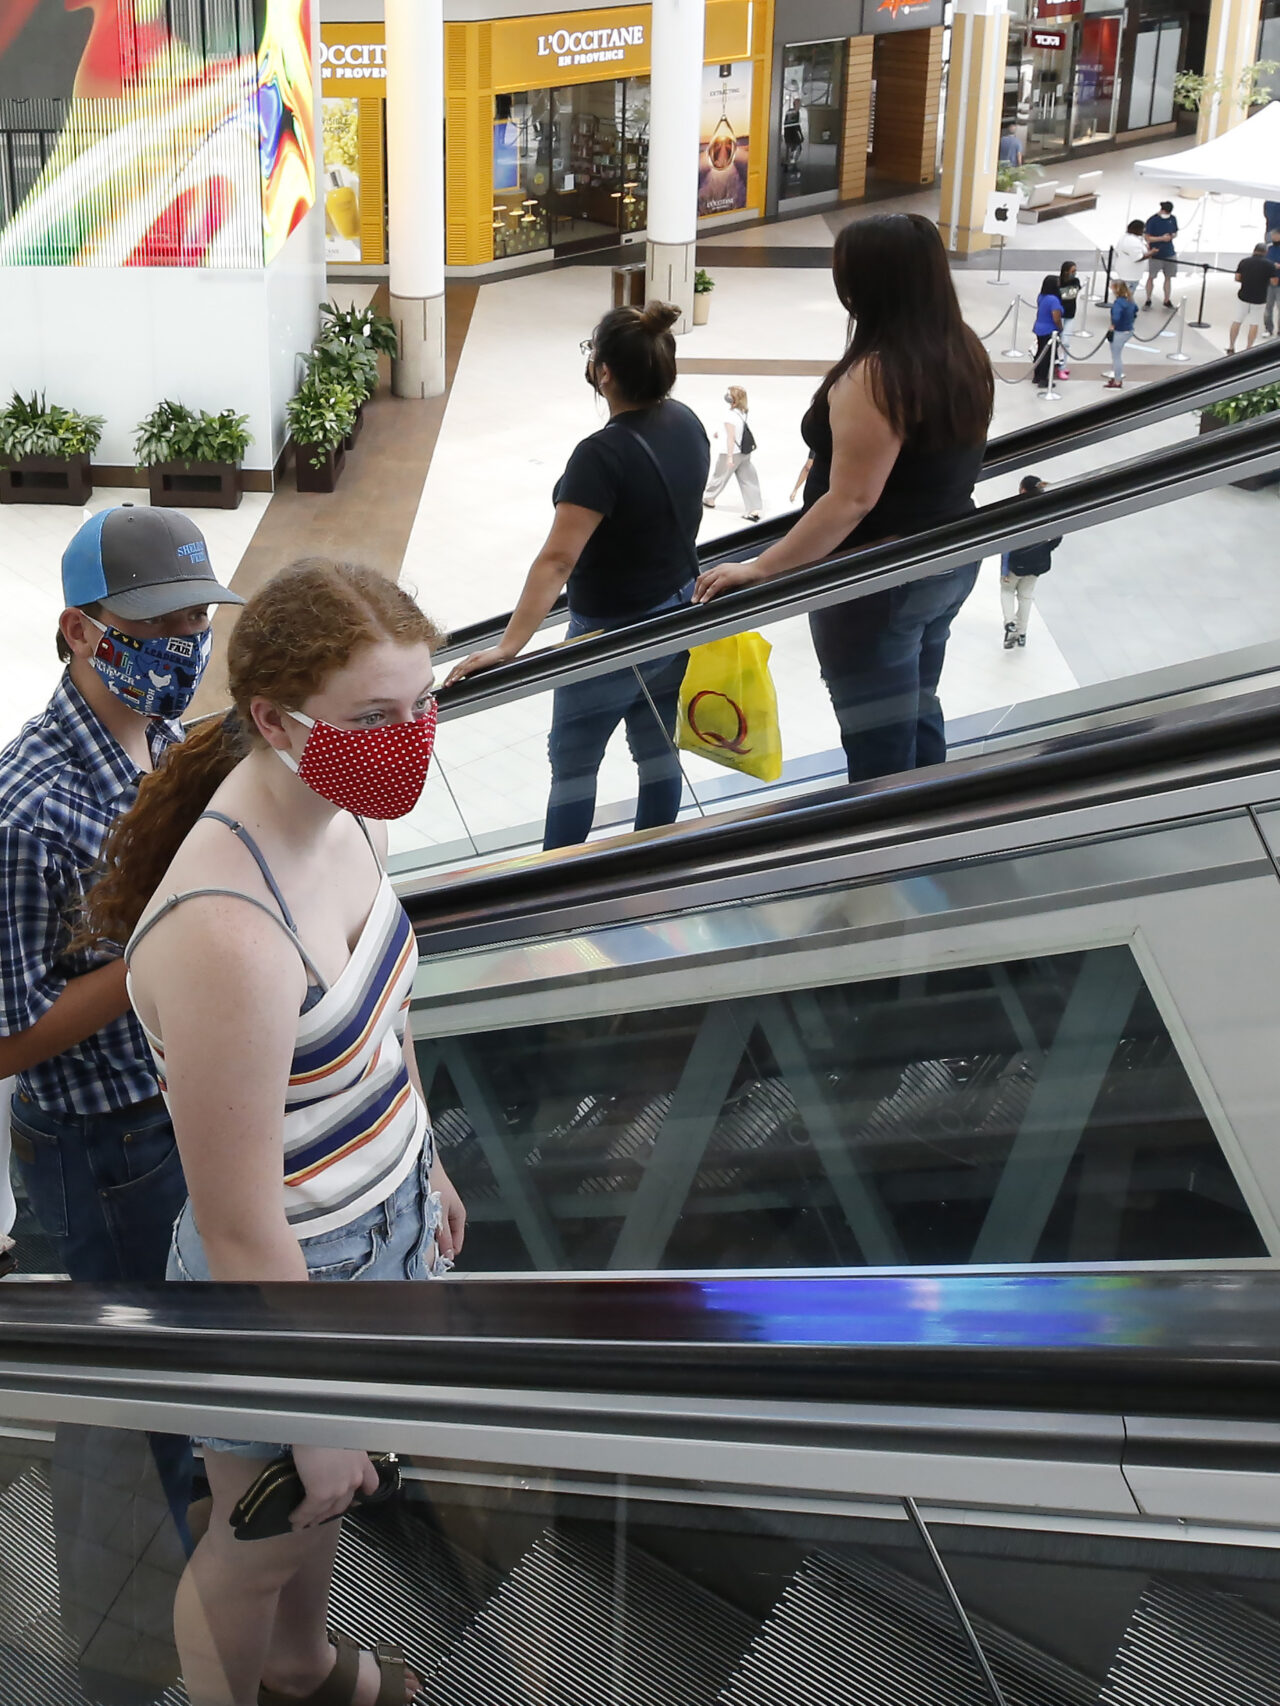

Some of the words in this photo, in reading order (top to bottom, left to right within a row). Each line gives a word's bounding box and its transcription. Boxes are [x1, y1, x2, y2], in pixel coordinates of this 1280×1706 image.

[537, 26, 644, 56] L'OCCITANE
[558, 55, 572, 67] EN
[574, 49, 624, 64] PROVENCE
[168, 643, 191, 657] FAIR
[687, 689, 753, 755] Q
